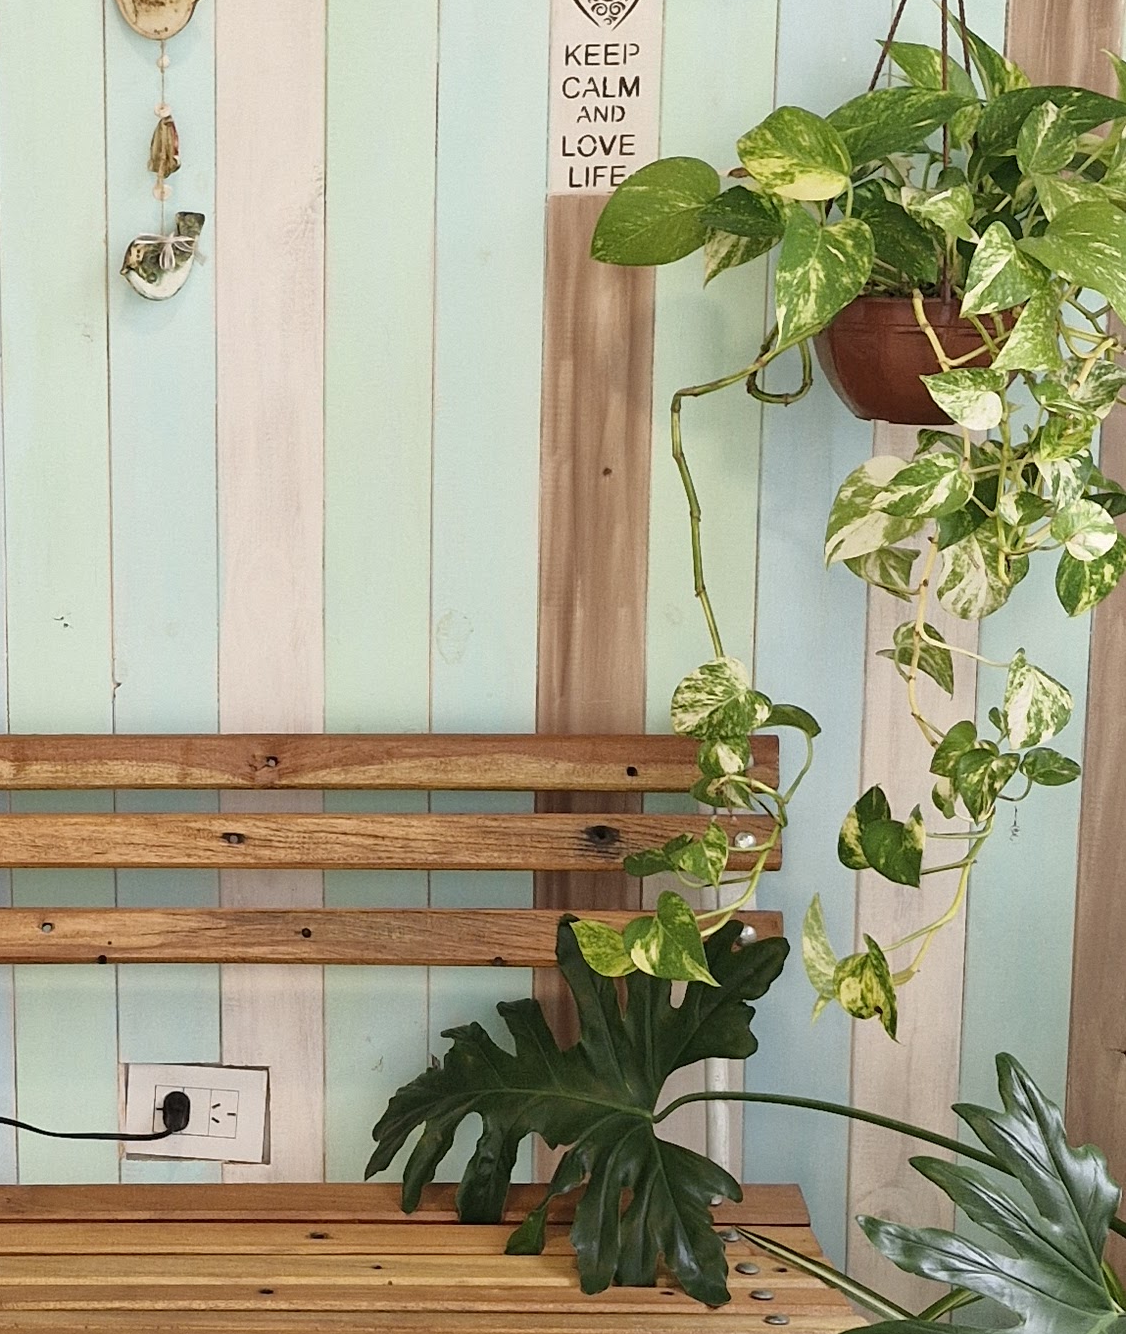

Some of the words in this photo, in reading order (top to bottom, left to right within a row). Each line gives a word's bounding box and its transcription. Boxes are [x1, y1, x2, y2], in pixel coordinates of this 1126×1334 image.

[565, 43, 640, 66] KEEP
[562, 75, 640, 99] CALM
[576, 105, 625, 123] AND
[562, 134, 636, 157] LOVE
[569, 165, 626, 188] LIFE
